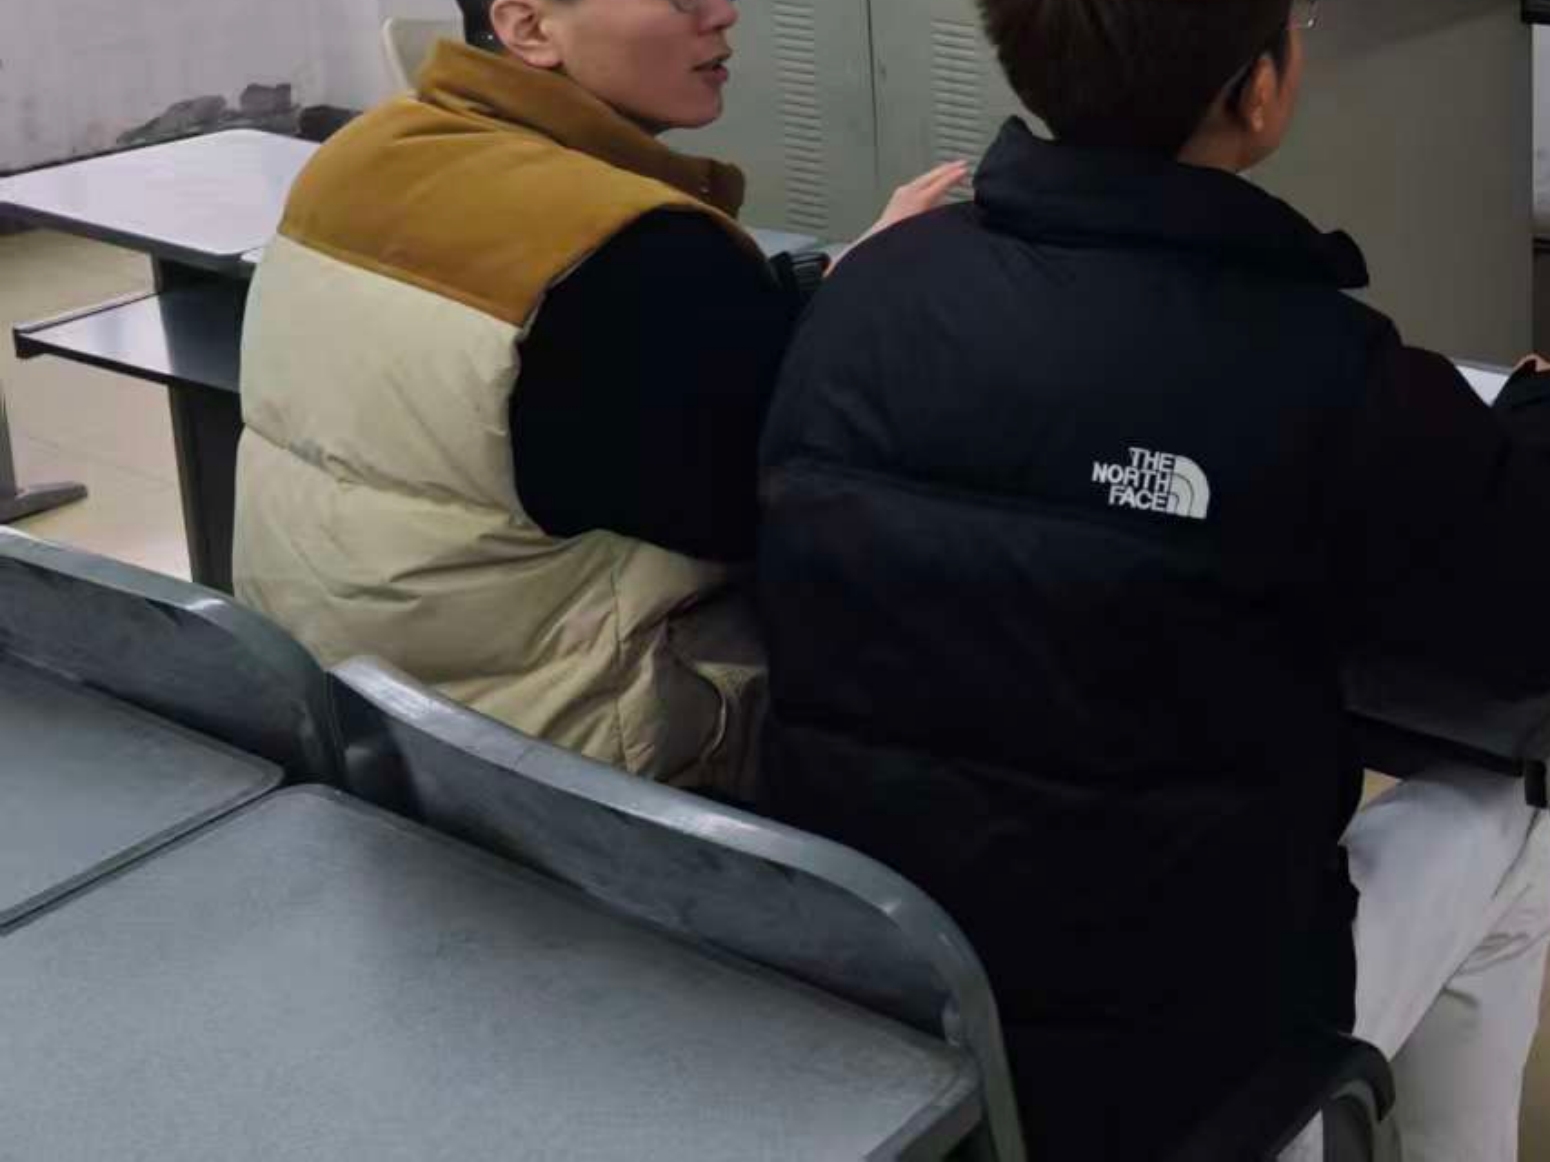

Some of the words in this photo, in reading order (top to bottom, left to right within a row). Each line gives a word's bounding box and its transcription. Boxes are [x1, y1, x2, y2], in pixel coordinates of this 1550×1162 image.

[1129, 446, 1175, 472] THE
[1092, 461, 1171, 494] NORTH
[1108, 485, 1168, 512] FACE
